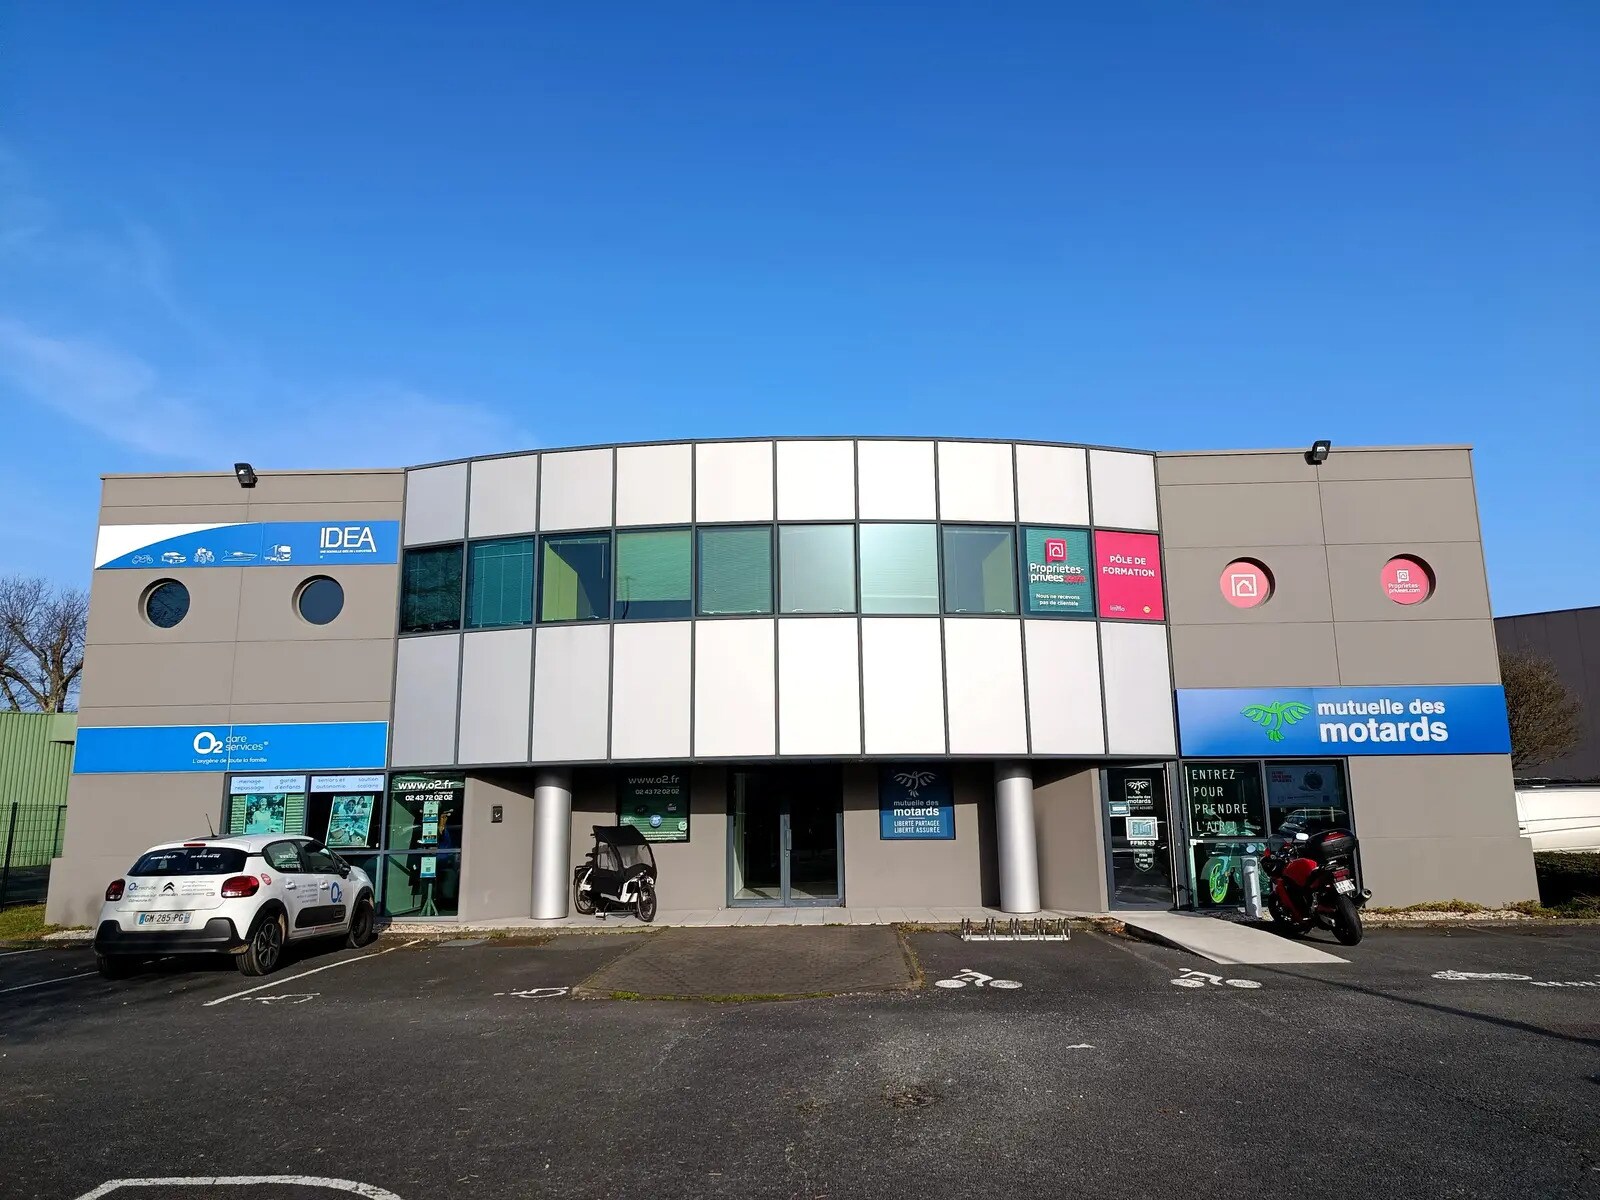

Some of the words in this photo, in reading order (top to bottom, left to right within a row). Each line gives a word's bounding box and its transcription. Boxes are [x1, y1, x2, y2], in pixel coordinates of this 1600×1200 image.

[320, 526, 377, 552] IDEA
[1109, 554, 1132, 565] PÔLE
[1134, 557, 1146, 565] DE
[1102, 566, 1155, 577] FORMATION
[1317, 699, 1404, 716] mutuelle
[1408, 698, 1446, 714] des
[1319, 716, 1449, 743] motards
[193, 731, 223, 754] O2
[225, 735, 247, 743] care
[628, 775, 680, 785] www.o2.fr
[1192, 769, 1236, 780] ENTREZ
[398, 780, 454, 791] www.o2.fr
[1193, 786, 1224, 797] POUR
[893, 806, 940, 816] motards
[1195, 803, 1249, 814] PRENDRE
